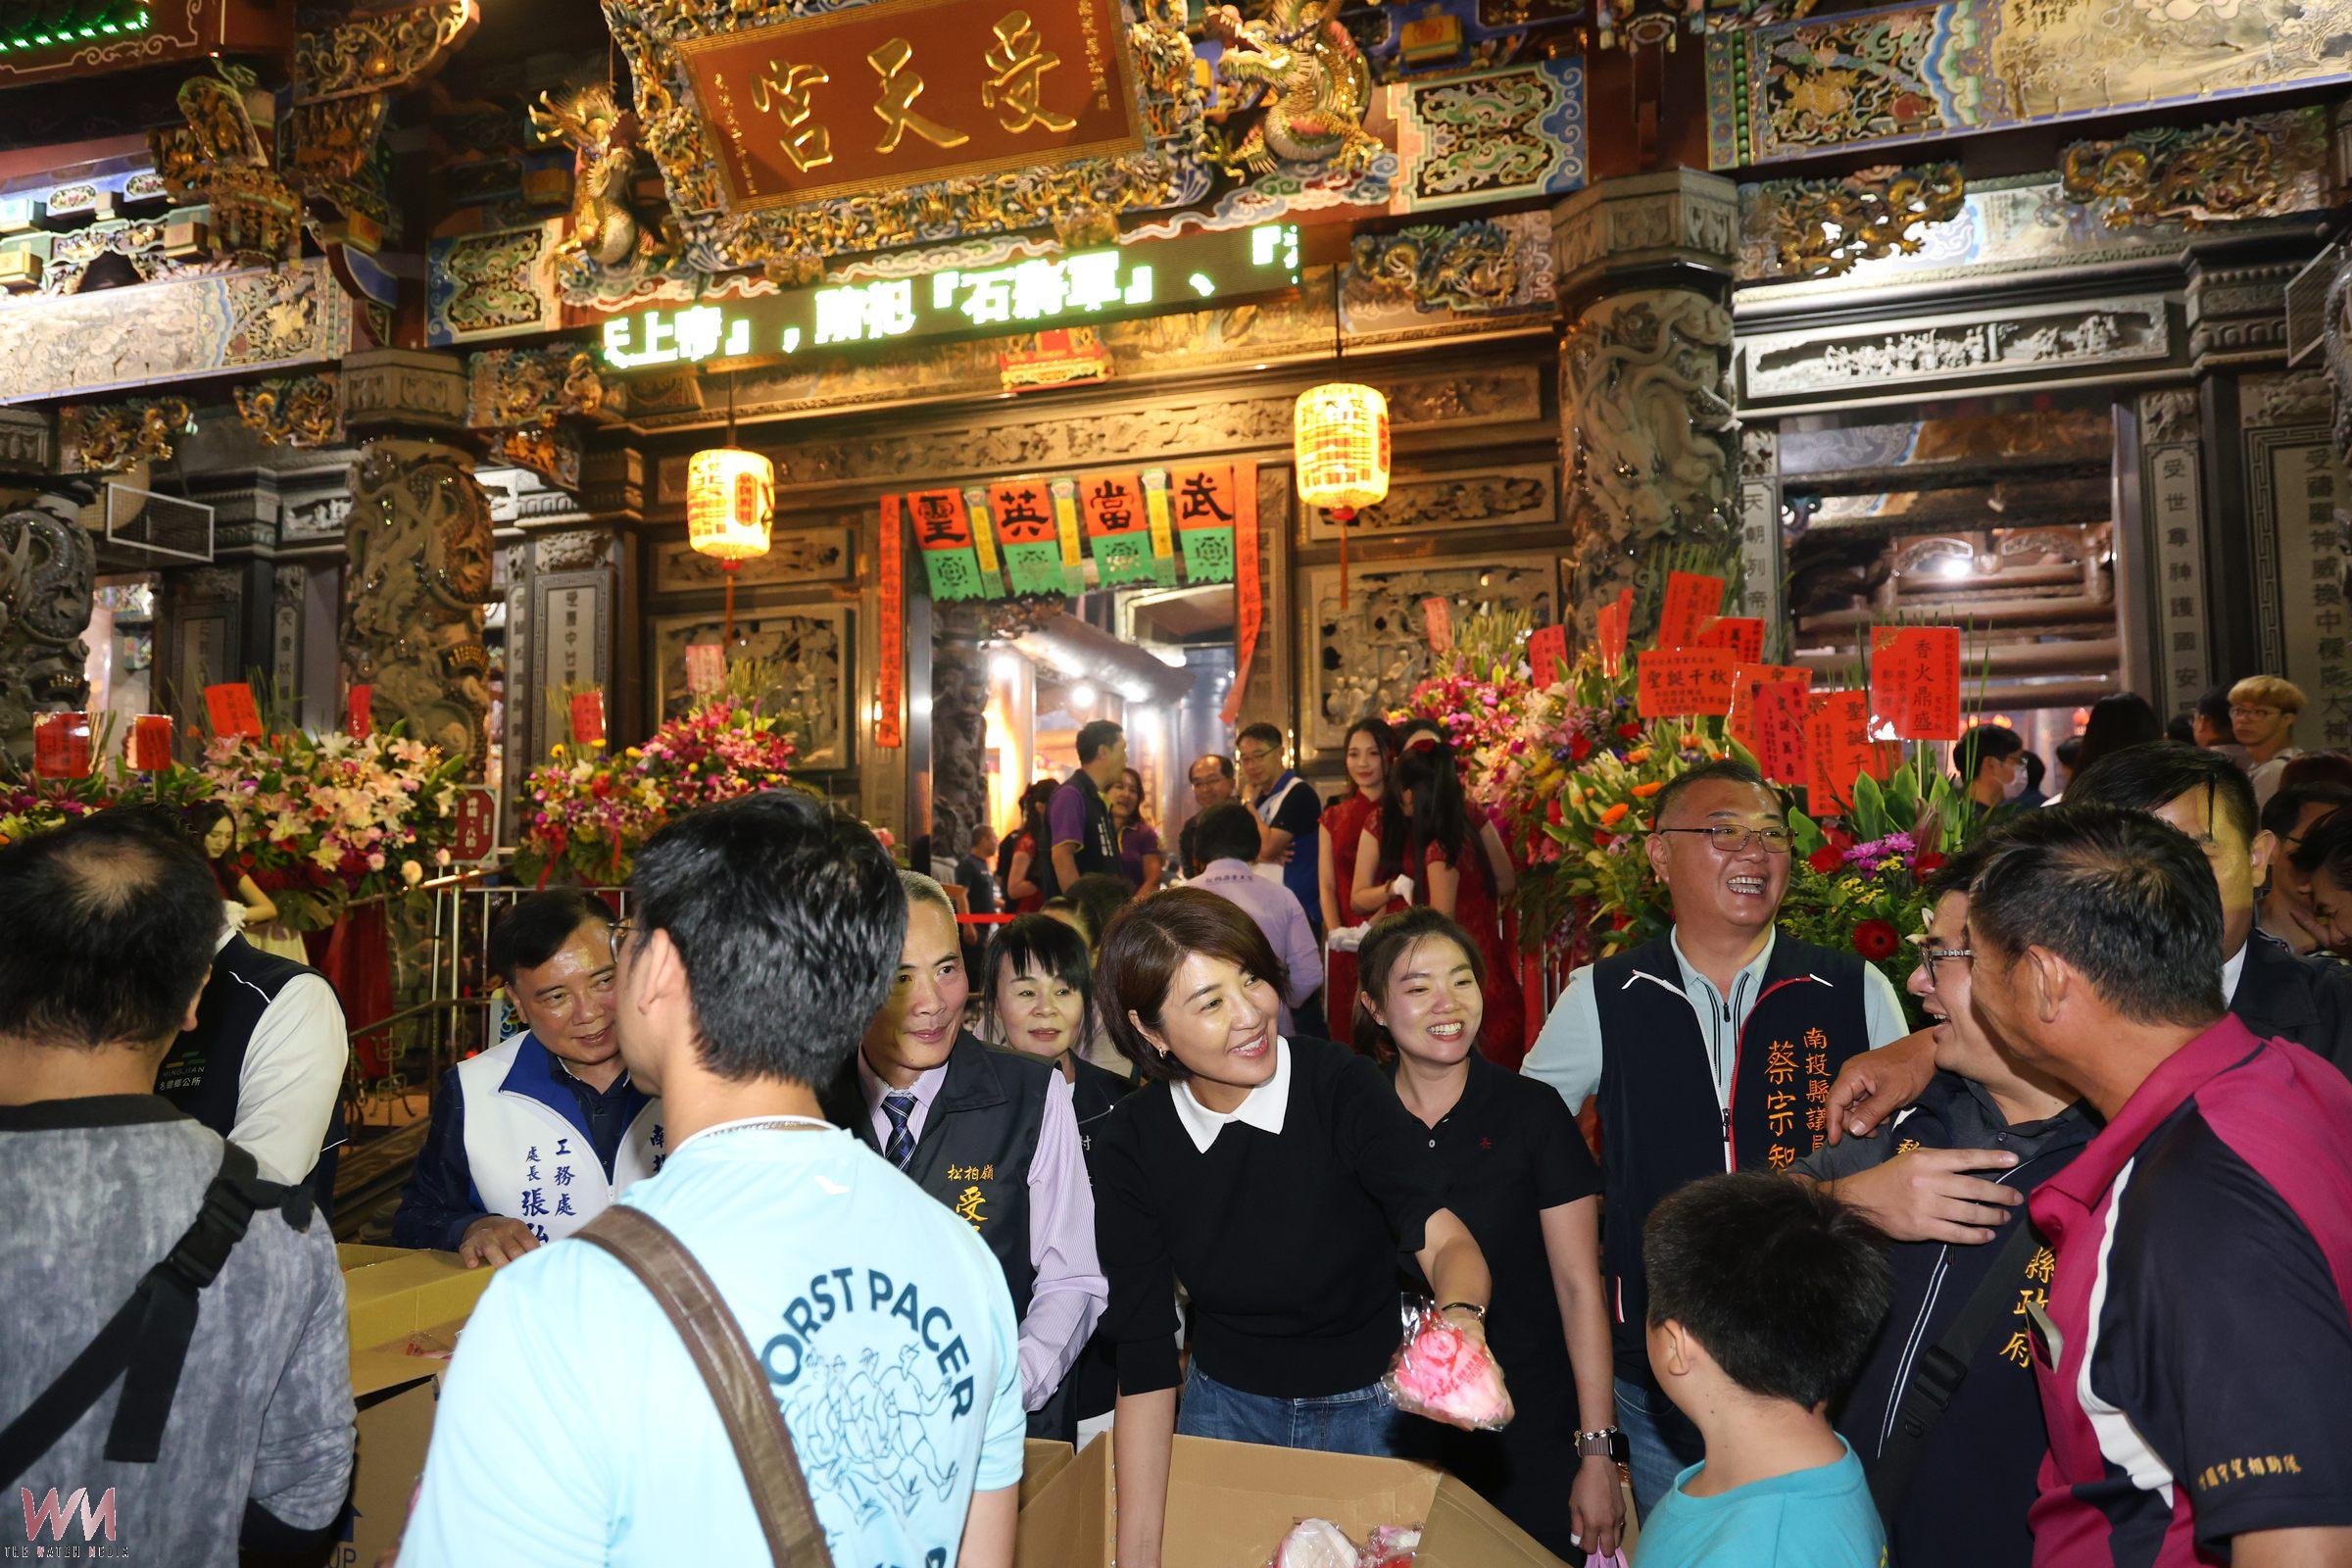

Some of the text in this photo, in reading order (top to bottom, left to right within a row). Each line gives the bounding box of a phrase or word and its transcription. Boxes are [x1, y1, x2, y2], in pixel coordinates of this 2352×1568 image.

[1913, 639, 1936, 731] 香火鼎盛
[553, 1138, 577, 1216] 工務處
[947, 1163, 994, 1182] 松柏嶺
[956, 1186, 989, 1232] 受
[760, 1267, 974, 1422] ORST PACER
